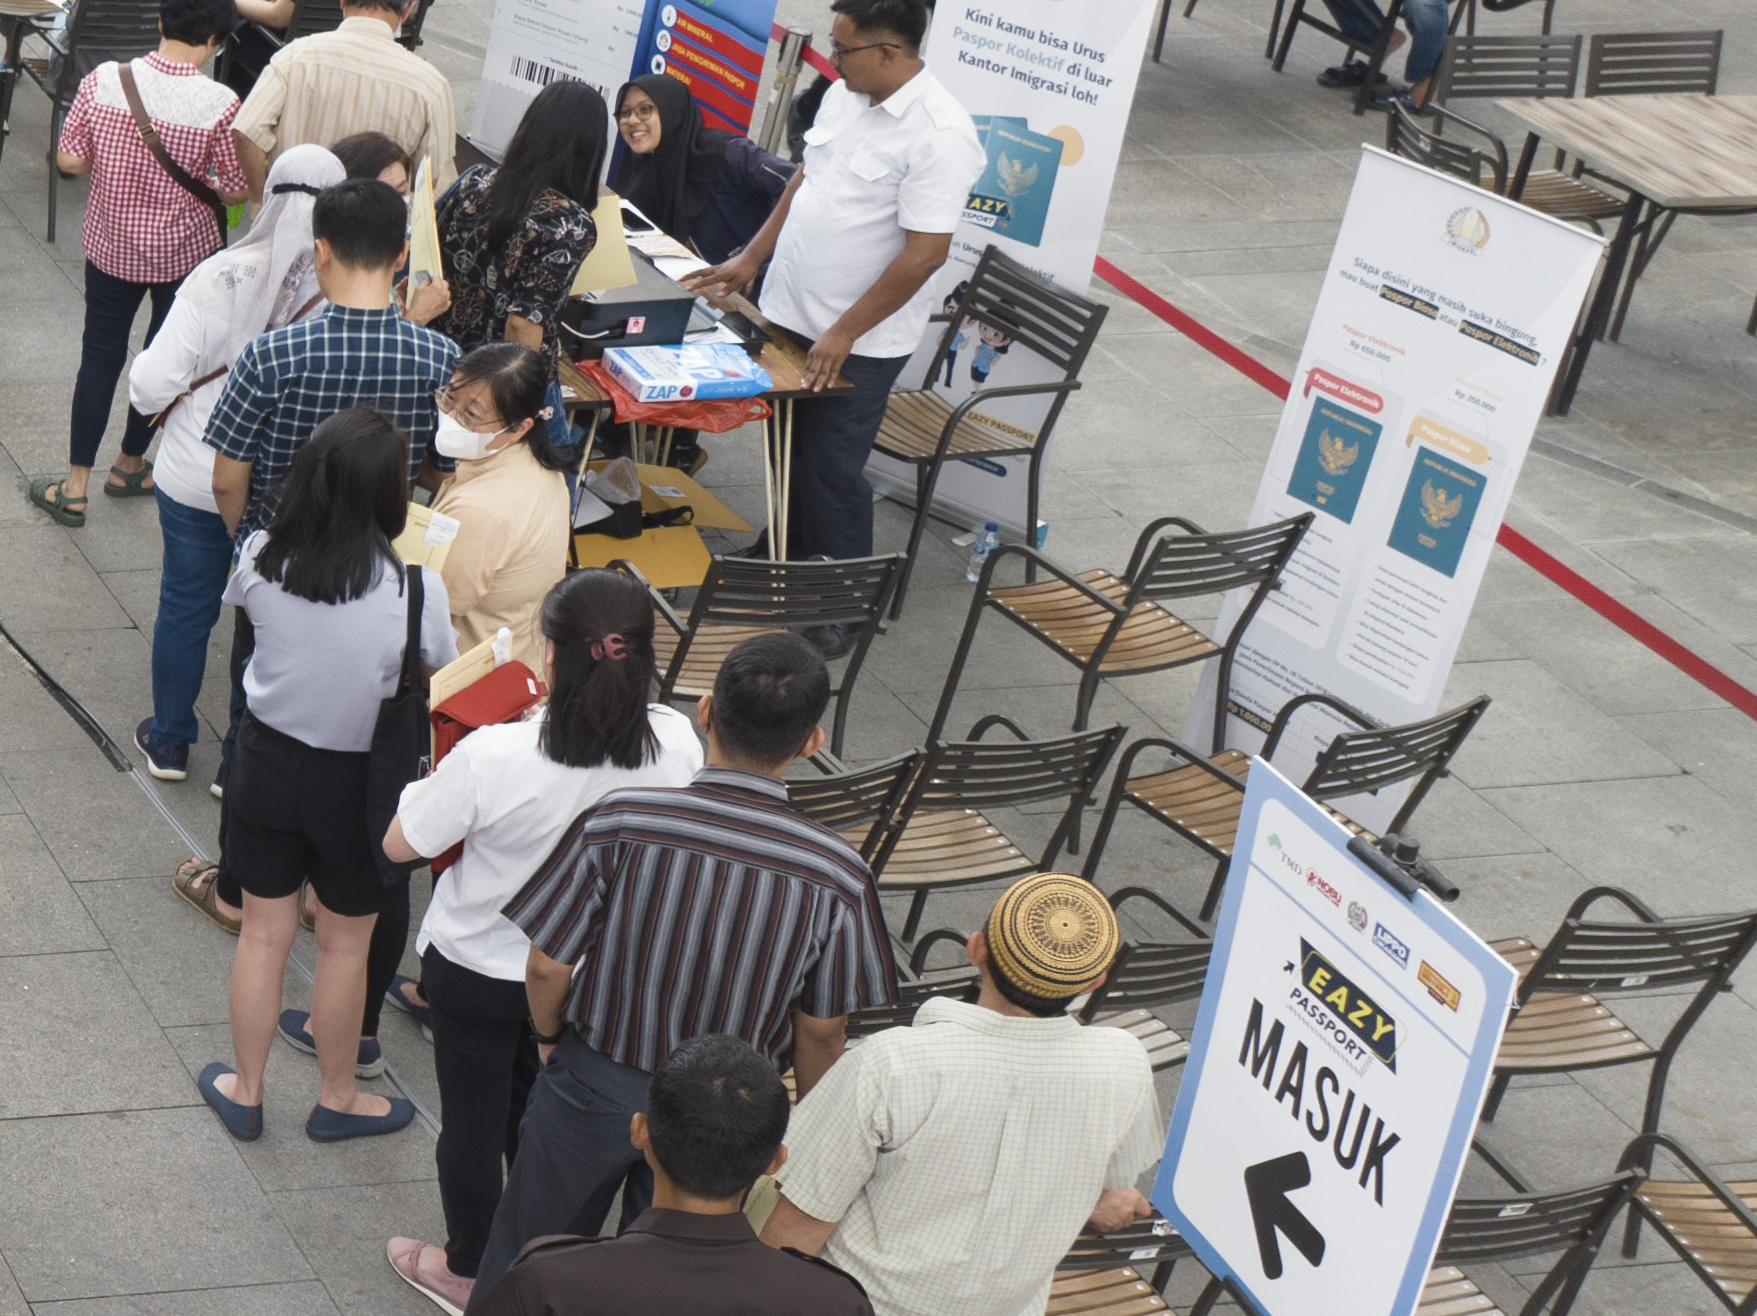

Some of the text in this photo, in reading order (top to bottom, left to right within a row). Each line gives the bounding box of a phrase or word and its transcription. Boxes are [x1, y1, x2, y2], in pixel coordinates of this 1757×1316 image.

[675, 17, 712, 42] AIR MINERAL
[965, 8, 1104, 63] Kini kamu bisa Urus
[670, 40, 745, 89] JASA PENGIRIMAN PASPOR
[953, 26, 1112, 87] Paspor Kolektif di luar
[958, 50, 1098, 105] Kantor Imigrasi loh!
[965, 192, 1007, 212] AZY
[1339, 270, 1540, 365] mau buat Paspor Biasa atau Paspor Elektronik
[1354, 257, 1536, 346] Siapa disini yang masih suka bingung,
[1342, 323, 1405, 355] Paspor Elektronik
[646, 385, 678, 400] ZAP
[1314, 373, 1379, 408] Paspor Elektronik
[967, 411, 1034, 442] EAZY PASSPORT
[1421, 424, 1445, 441] Paspor
[1281, 852, 1302, 875] TMD
[1317, 878, 1341, 903] NOBU
[1375, 925, 1406, 960] LIPPO
[1309, 968, 1394, 1040] EAZY
[1290, 988, 1365, 1059] PASSPORT
[1241, 1002, 1397, 1202] MASUK
